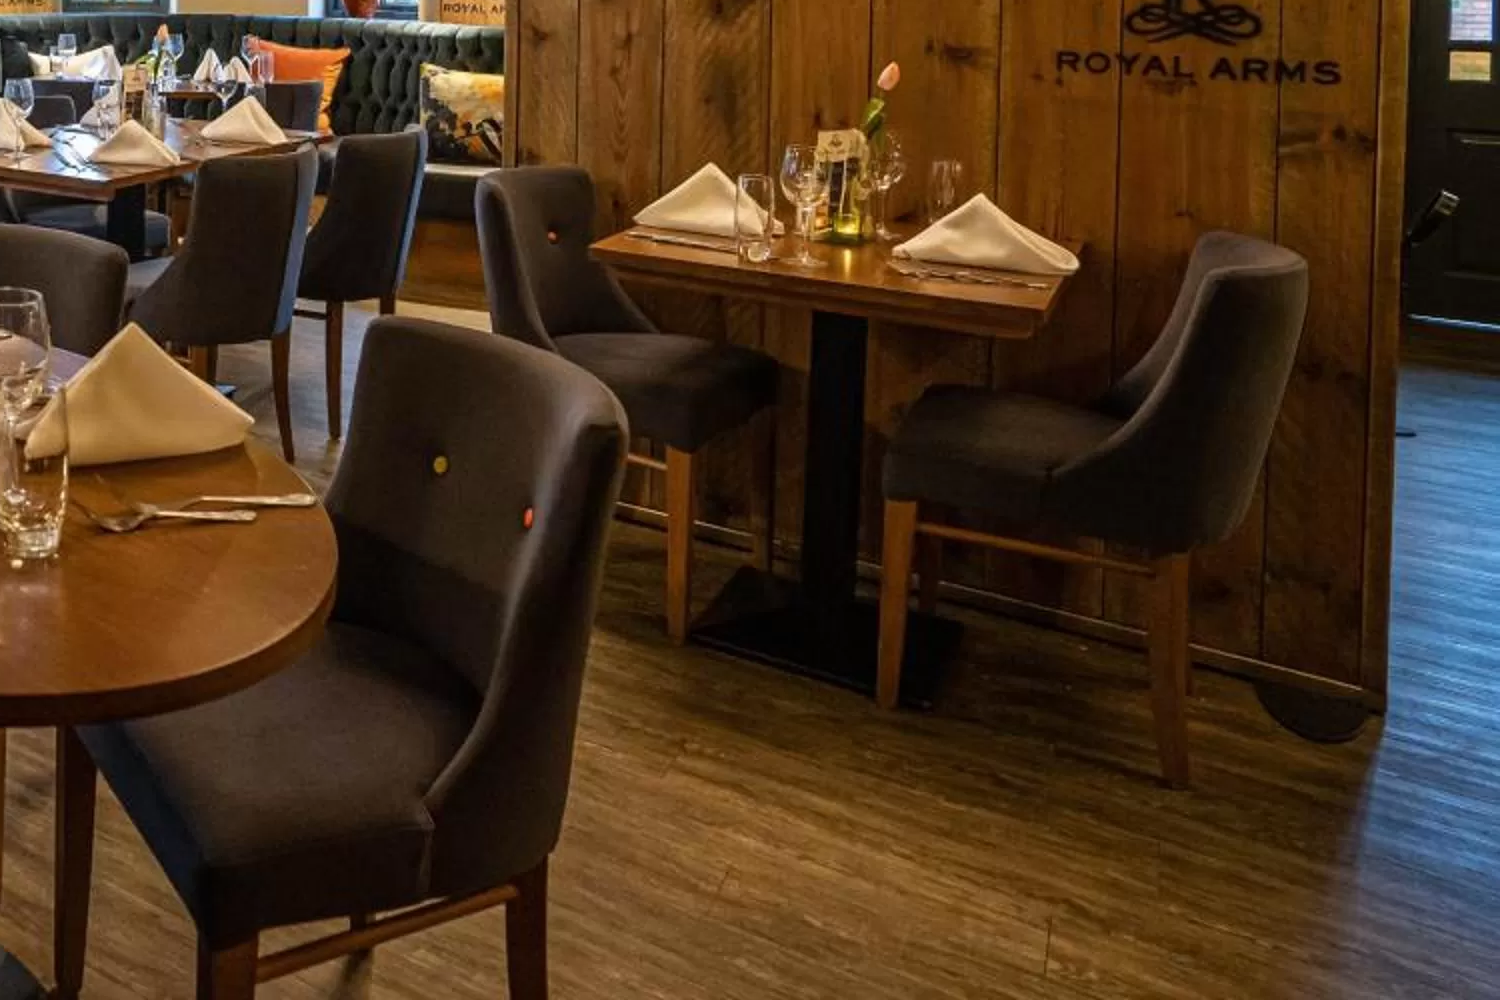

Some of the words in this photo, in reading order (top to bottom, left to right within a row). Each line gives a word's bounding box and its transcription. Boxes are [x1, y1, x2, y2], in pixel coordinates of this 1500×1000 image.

[443, 3, 487, 14] ROYAL
[1055, 51, 1195, 79] ROYAL
[1208, 56, 1342, 86] ARMS
